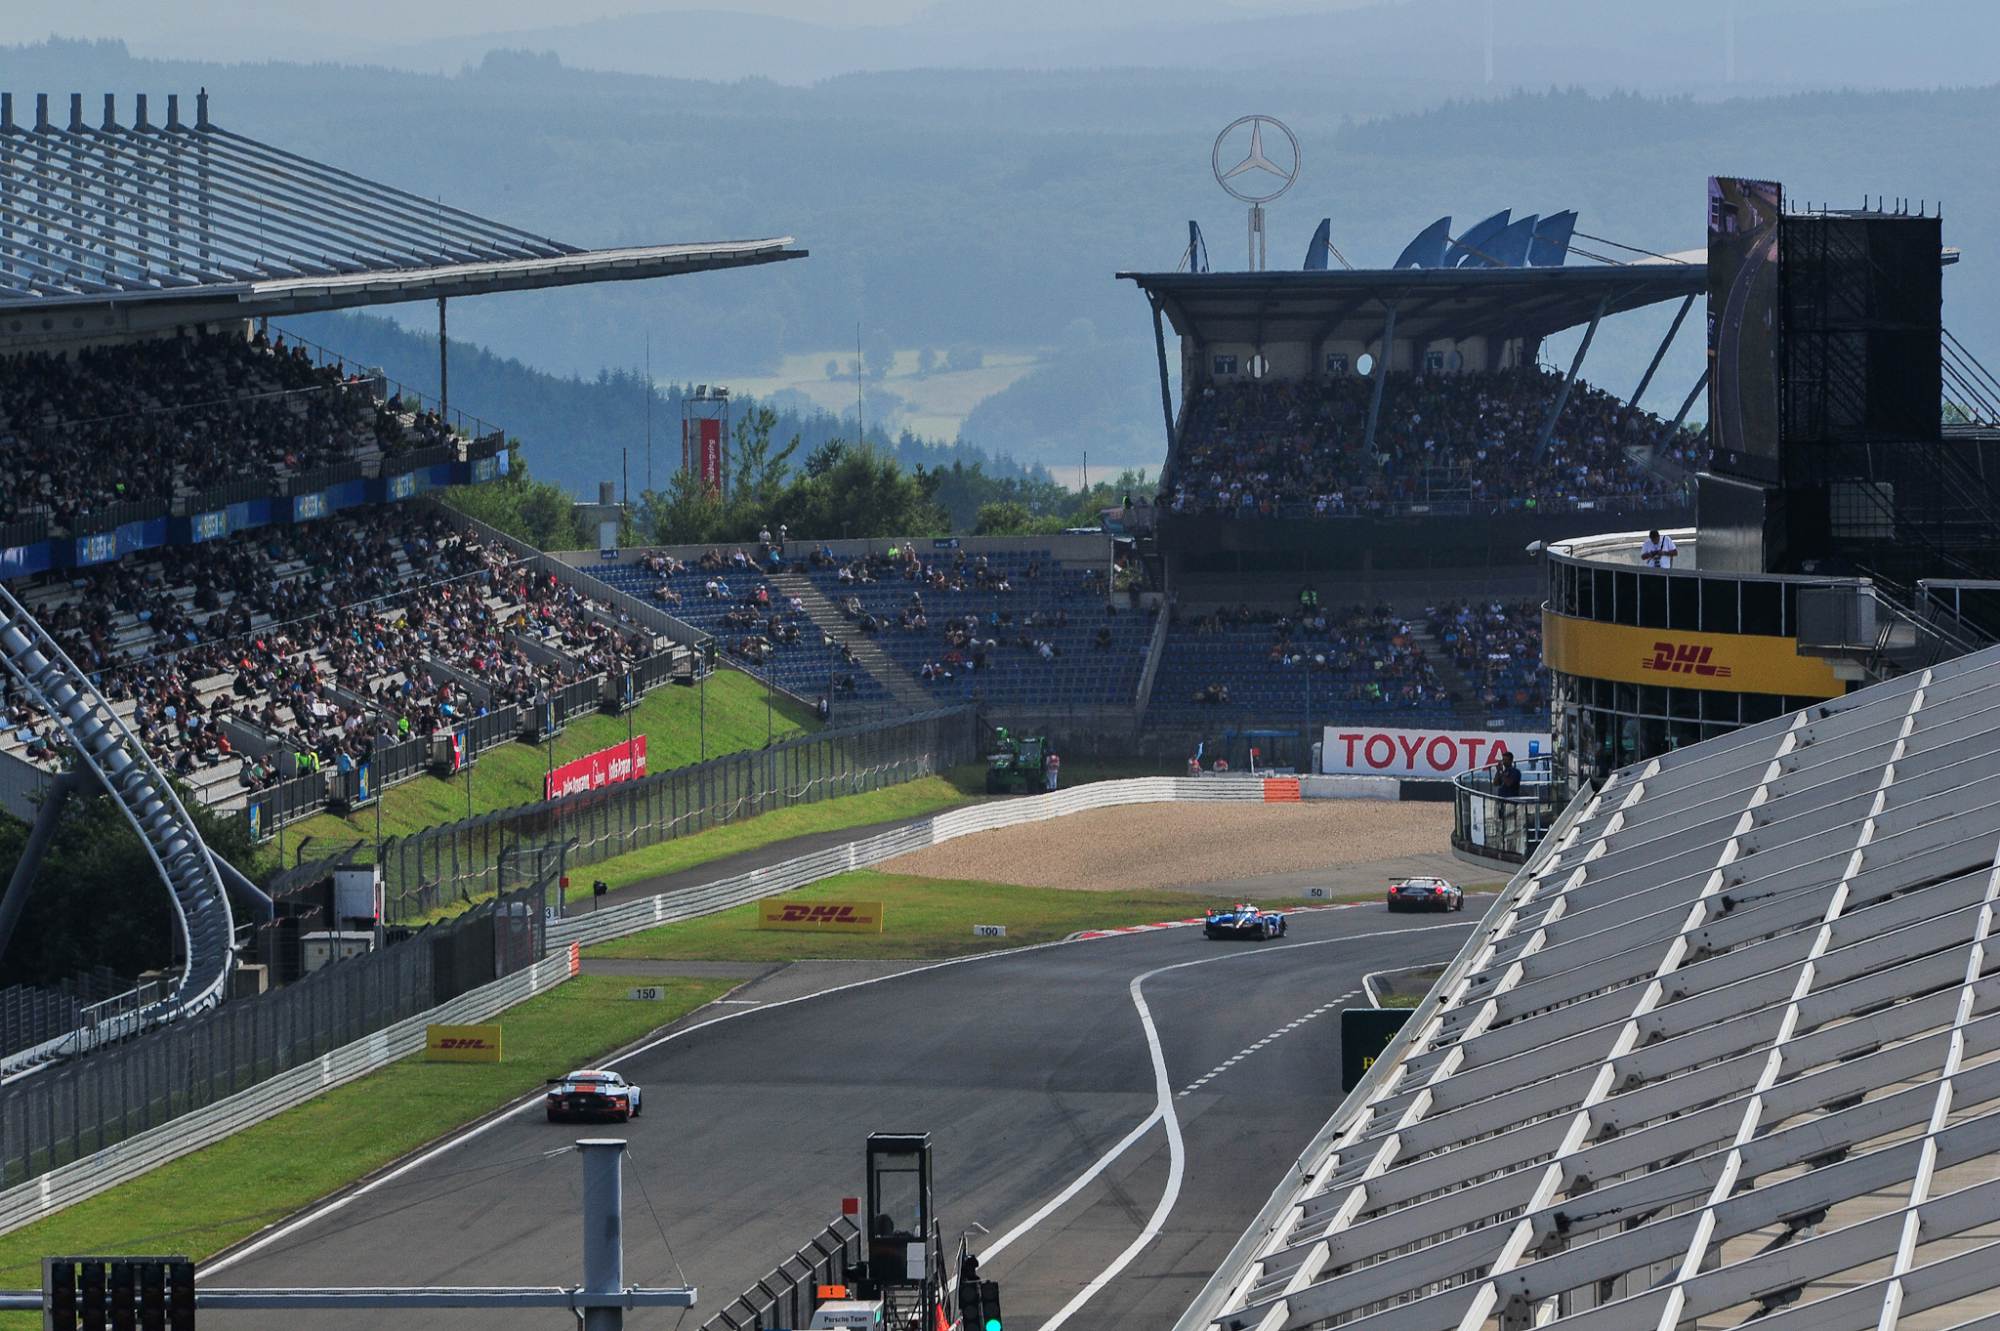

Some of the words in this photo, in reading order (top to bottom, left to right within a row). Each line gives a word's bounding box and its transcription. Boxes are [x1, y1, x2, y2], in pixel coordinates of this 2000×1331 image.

[1650, 642, 1719, 677] DHL
[1339, 733, 1510, 772] TOYOTA
[1311, 888, 1322, 897] 50
[779, 905, 859, 923] DHL
[980, 927, 998, 937] 100
[636, 988, 656, 999] 150
[439, 1039, 487, 1049] DHL
[823, 1315, 850, 1323] Porsche
